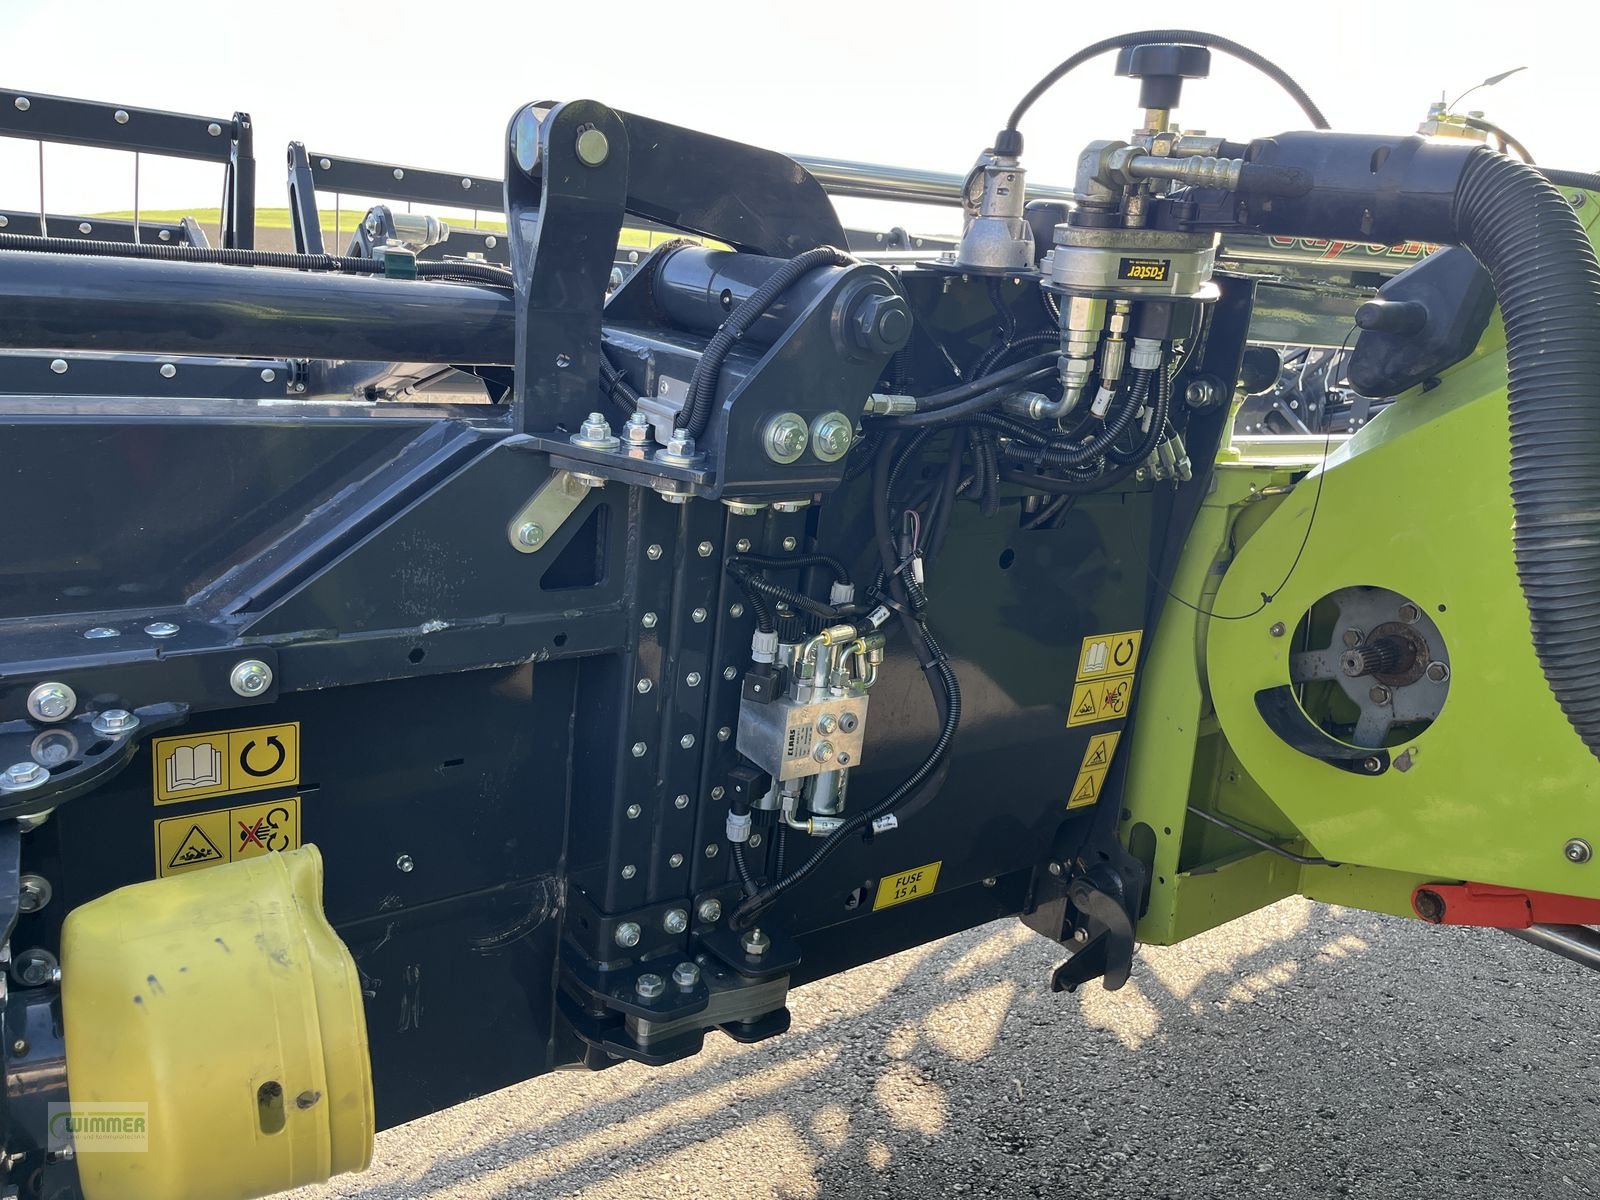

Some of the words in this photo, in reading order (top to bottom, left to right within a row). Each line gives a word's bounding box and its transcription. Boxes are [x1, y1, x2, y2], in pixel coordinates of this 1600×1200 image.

[1127, 265, 1165, 280] Faster
[896, 871, 924, 888] FUSE
[894, 887, 907, 900] 15
[909, 884, 918, 896] A
